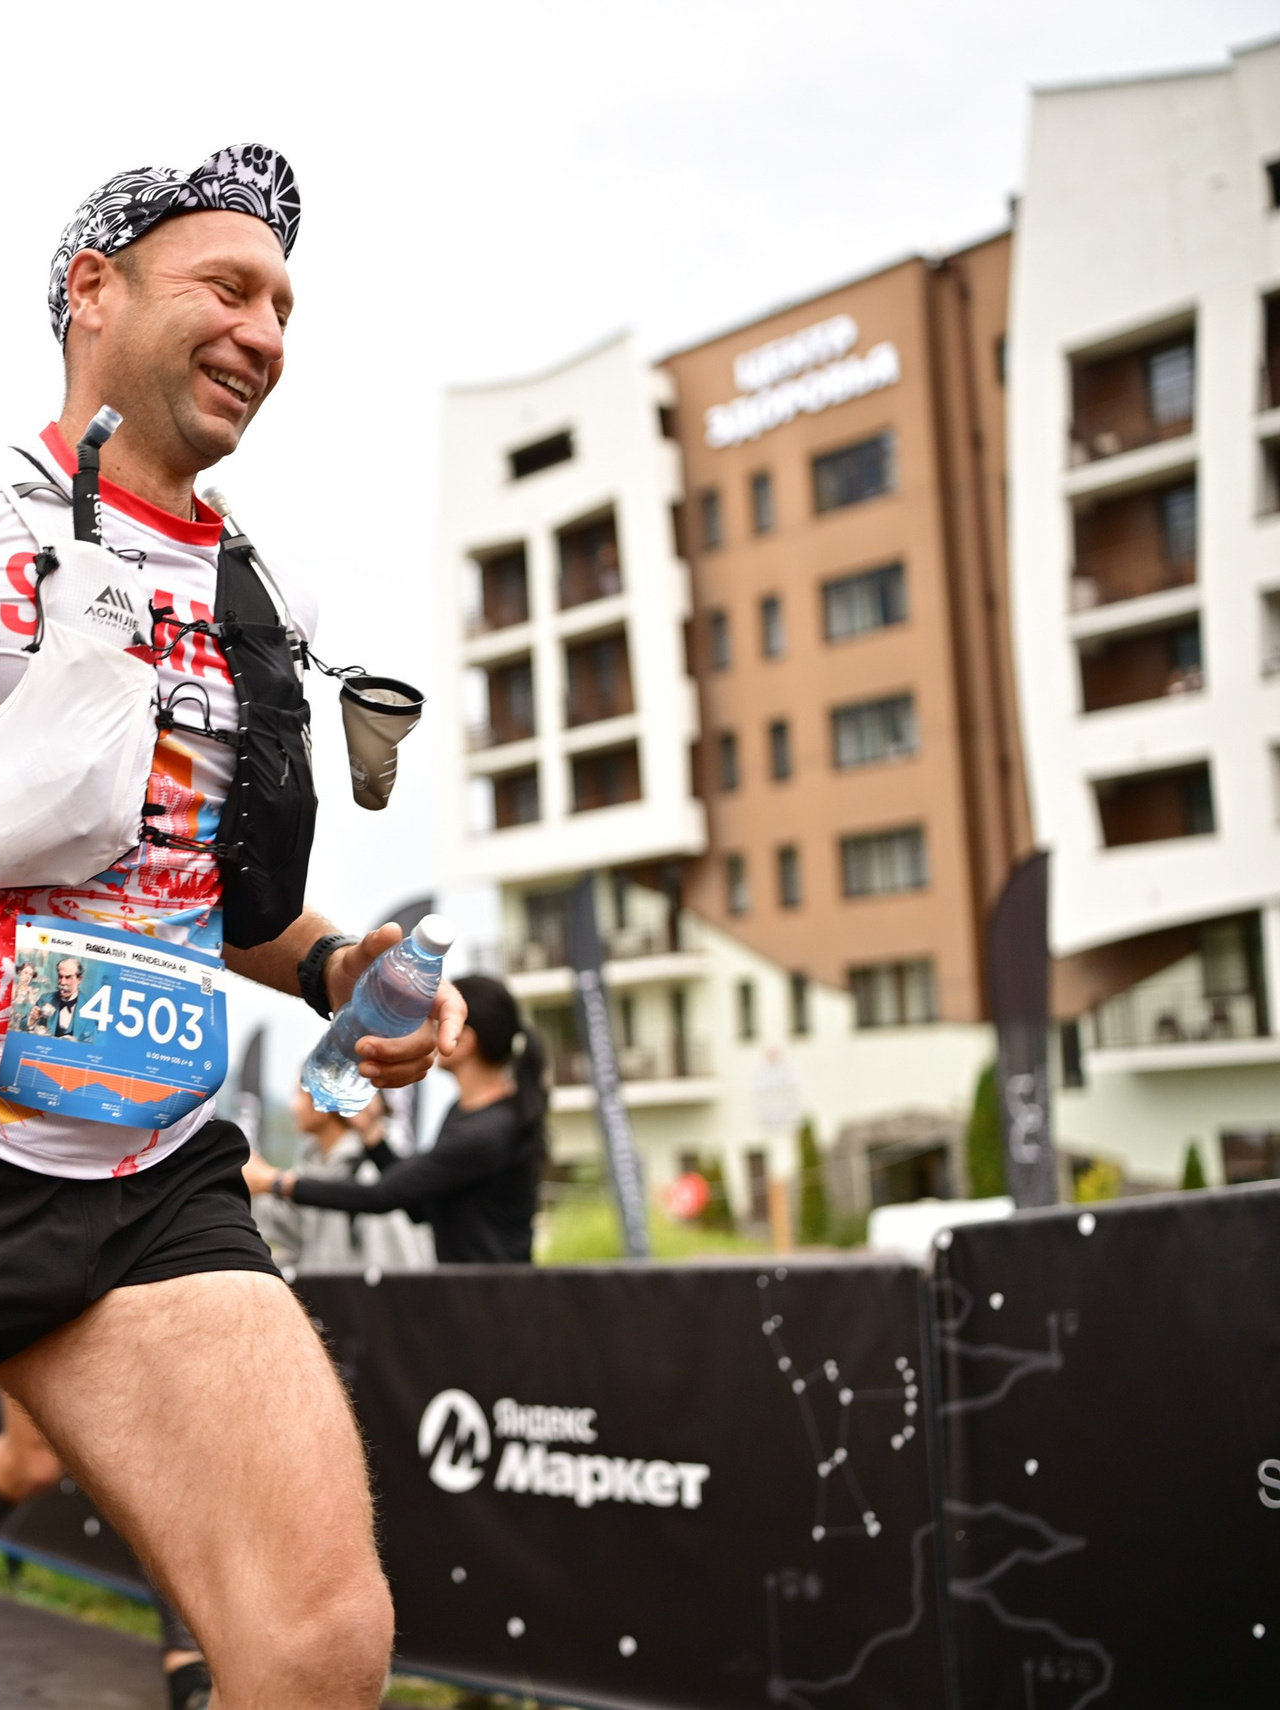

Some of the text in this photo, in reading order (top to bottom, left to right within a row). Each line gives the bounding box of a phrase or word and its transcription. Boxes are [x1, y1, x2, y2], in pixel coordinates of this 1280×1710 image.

[84, 605, 140, 632] AONIJIE
[79, 985, 204, 1051] 4503
[493, 1397, 598, 1444] Яндекс
[493, 1441, 710, 1509] Маркет
